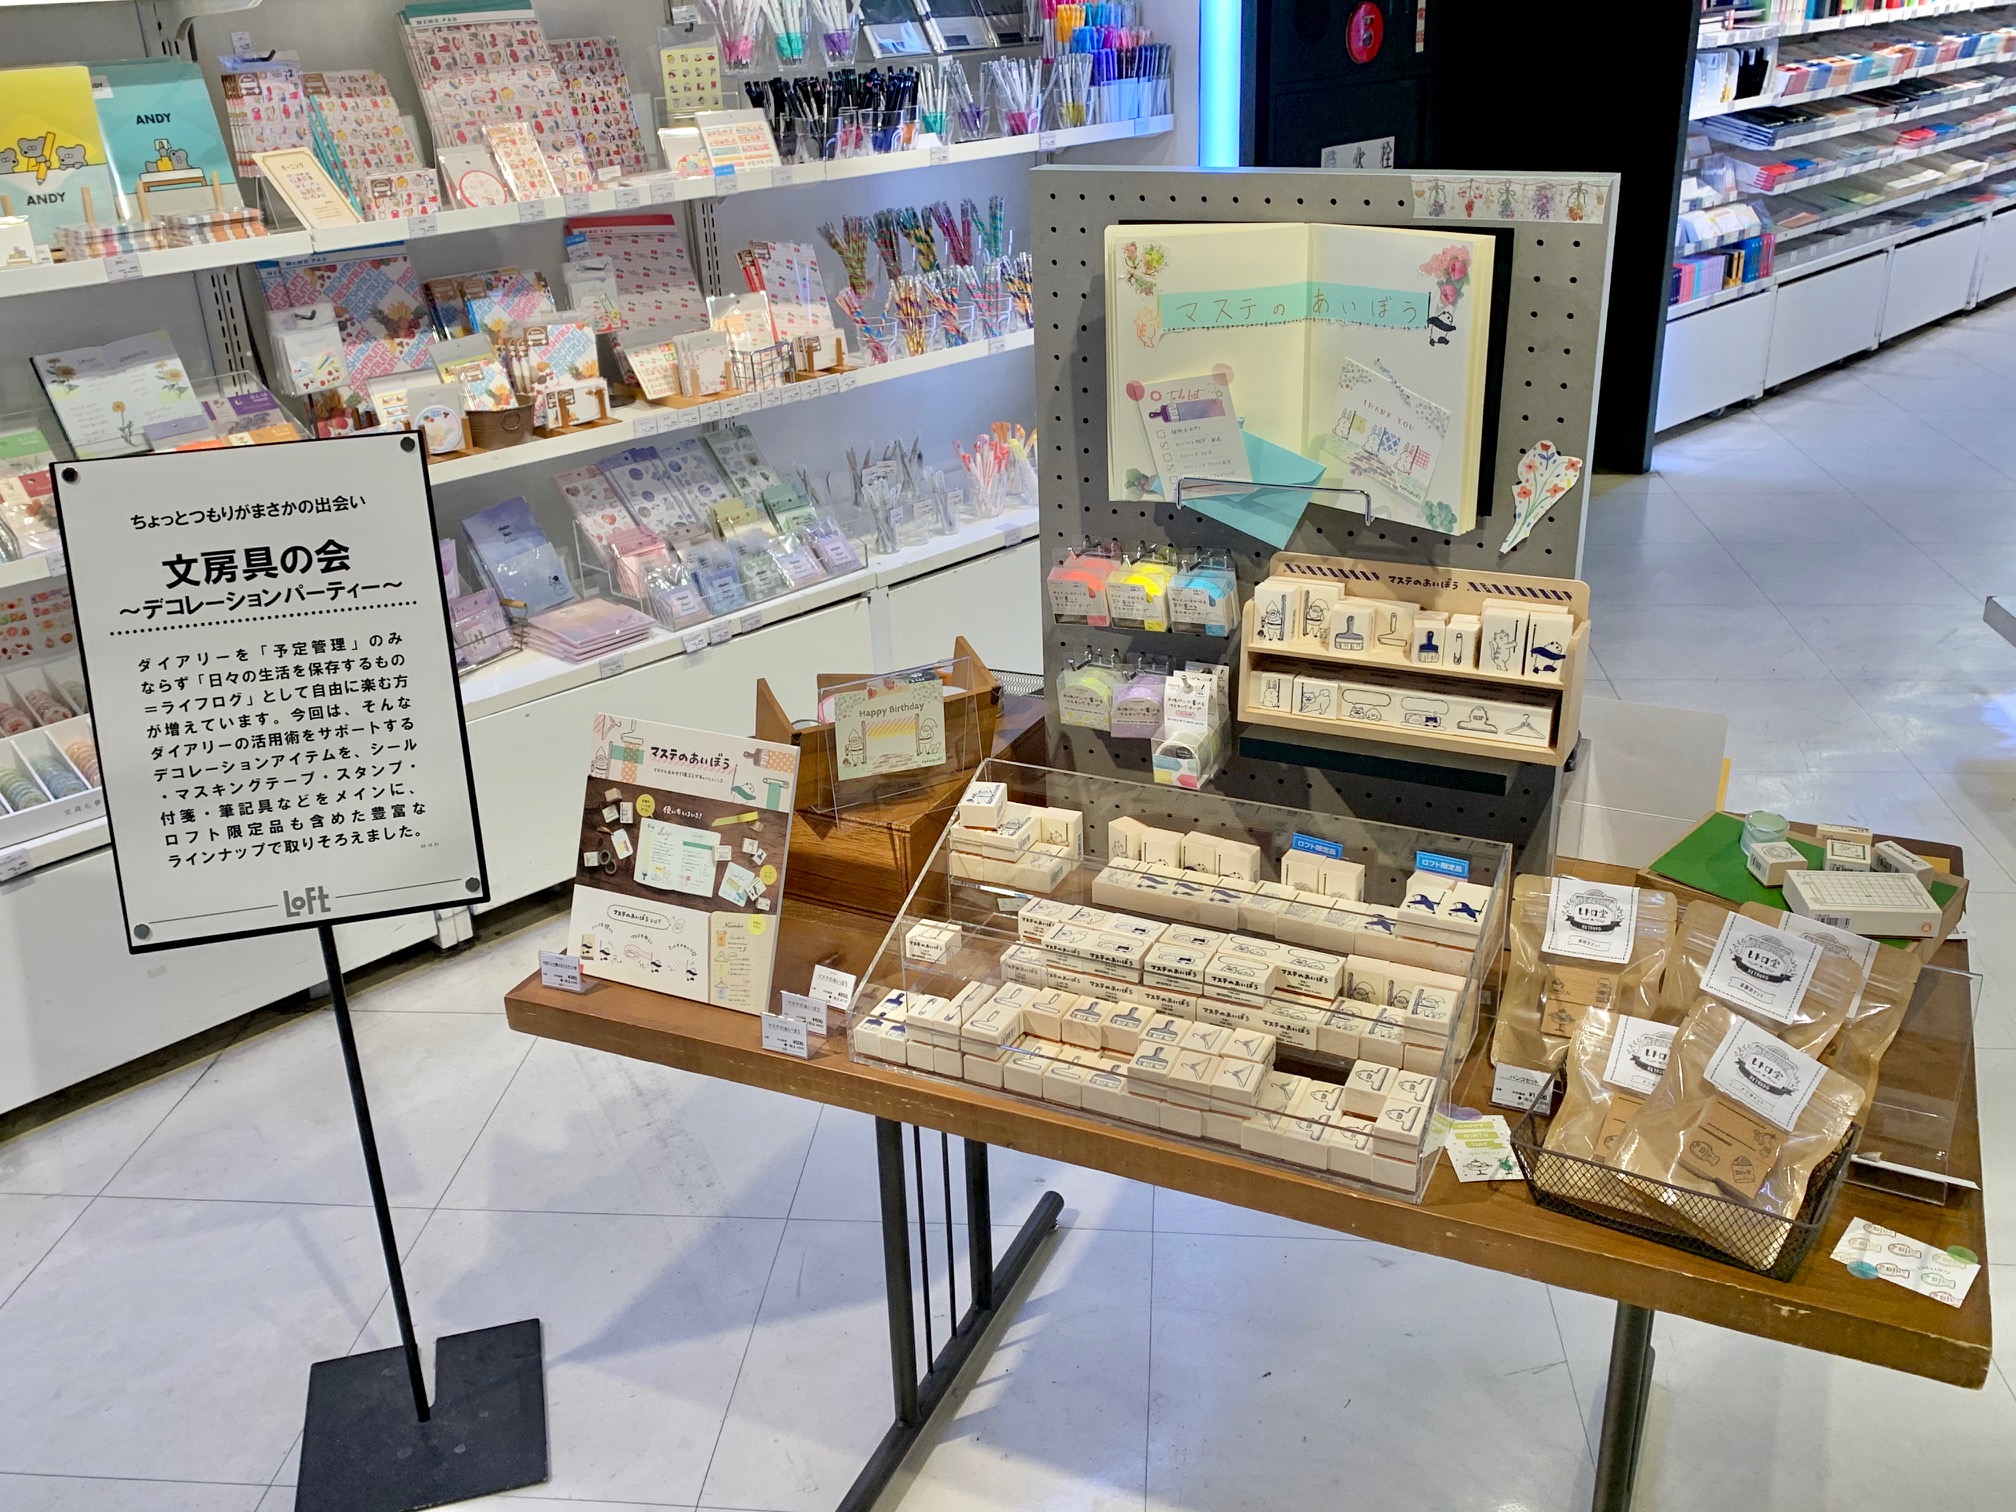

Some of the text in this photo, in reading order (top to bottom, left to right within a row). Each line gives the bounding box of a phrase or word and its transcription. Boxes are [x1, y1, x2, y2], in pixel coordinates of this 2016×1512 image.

[136, 112, 172, 126] ANDY
[26, 192, 66, 206] ANDY
[1176, 291, 1418, 325] マステのあいぼう
[1363, 400, 1414, 432] THANK YOU
[130, 494, 366, 530] ちょっとつもりがまさかの出会い
[162, 539, 351, 590] 文房具の会
[1388, 575, 1460, 590] マステのあいぼう
[138, 632, 403, 674] ダイアリーを「予定管理」のみ
[141, 653, 405, 694] ならず「日々の生活を保存するもの
[146, 696, 412, 739] が増えています。今回は、そんな
[859, 702, 925, 718] Happy Birthday
[150, 717, 414, 761] ダイアリーの活用術をサポートする
[154, 737, 418, 783] デコレーションアイテムを、シール
[650, 746, 730, 770] マステのあいぼう
[160, 784, 417, 826] 付箋・筆記具などをメインに、
[165, 802, 426, 846] ロフト限定品も含めた豊富な
[168, 830, 422, 868] ラインナップで取りそろえました。
[1298, 841, 1336, 856] ロフト限定品
[1422, 859, 1462, 873] ロフト限定品
[1090, 953, 1134, 966] マステのあいぼう
[1150, 965, 1197, 978] マステのあいぼう
[1282, 969, 1328, 984] マステのあいぼう
[1090, 981, 1133, 995] マステのあいぼう
[1211, 976, 1258, 990] マステのあいぼう
[1145, 993, 1190, 1008] マステのあいぼう
[1202, 1007, 1250, 1022] マステのあいぼう
[1262, 1020, 1310, 1036] マステのあいぼう
[1644, 1048, 1668, 1061] レトロ
[1509, 1075, 1539, 1085] ハンコセット
